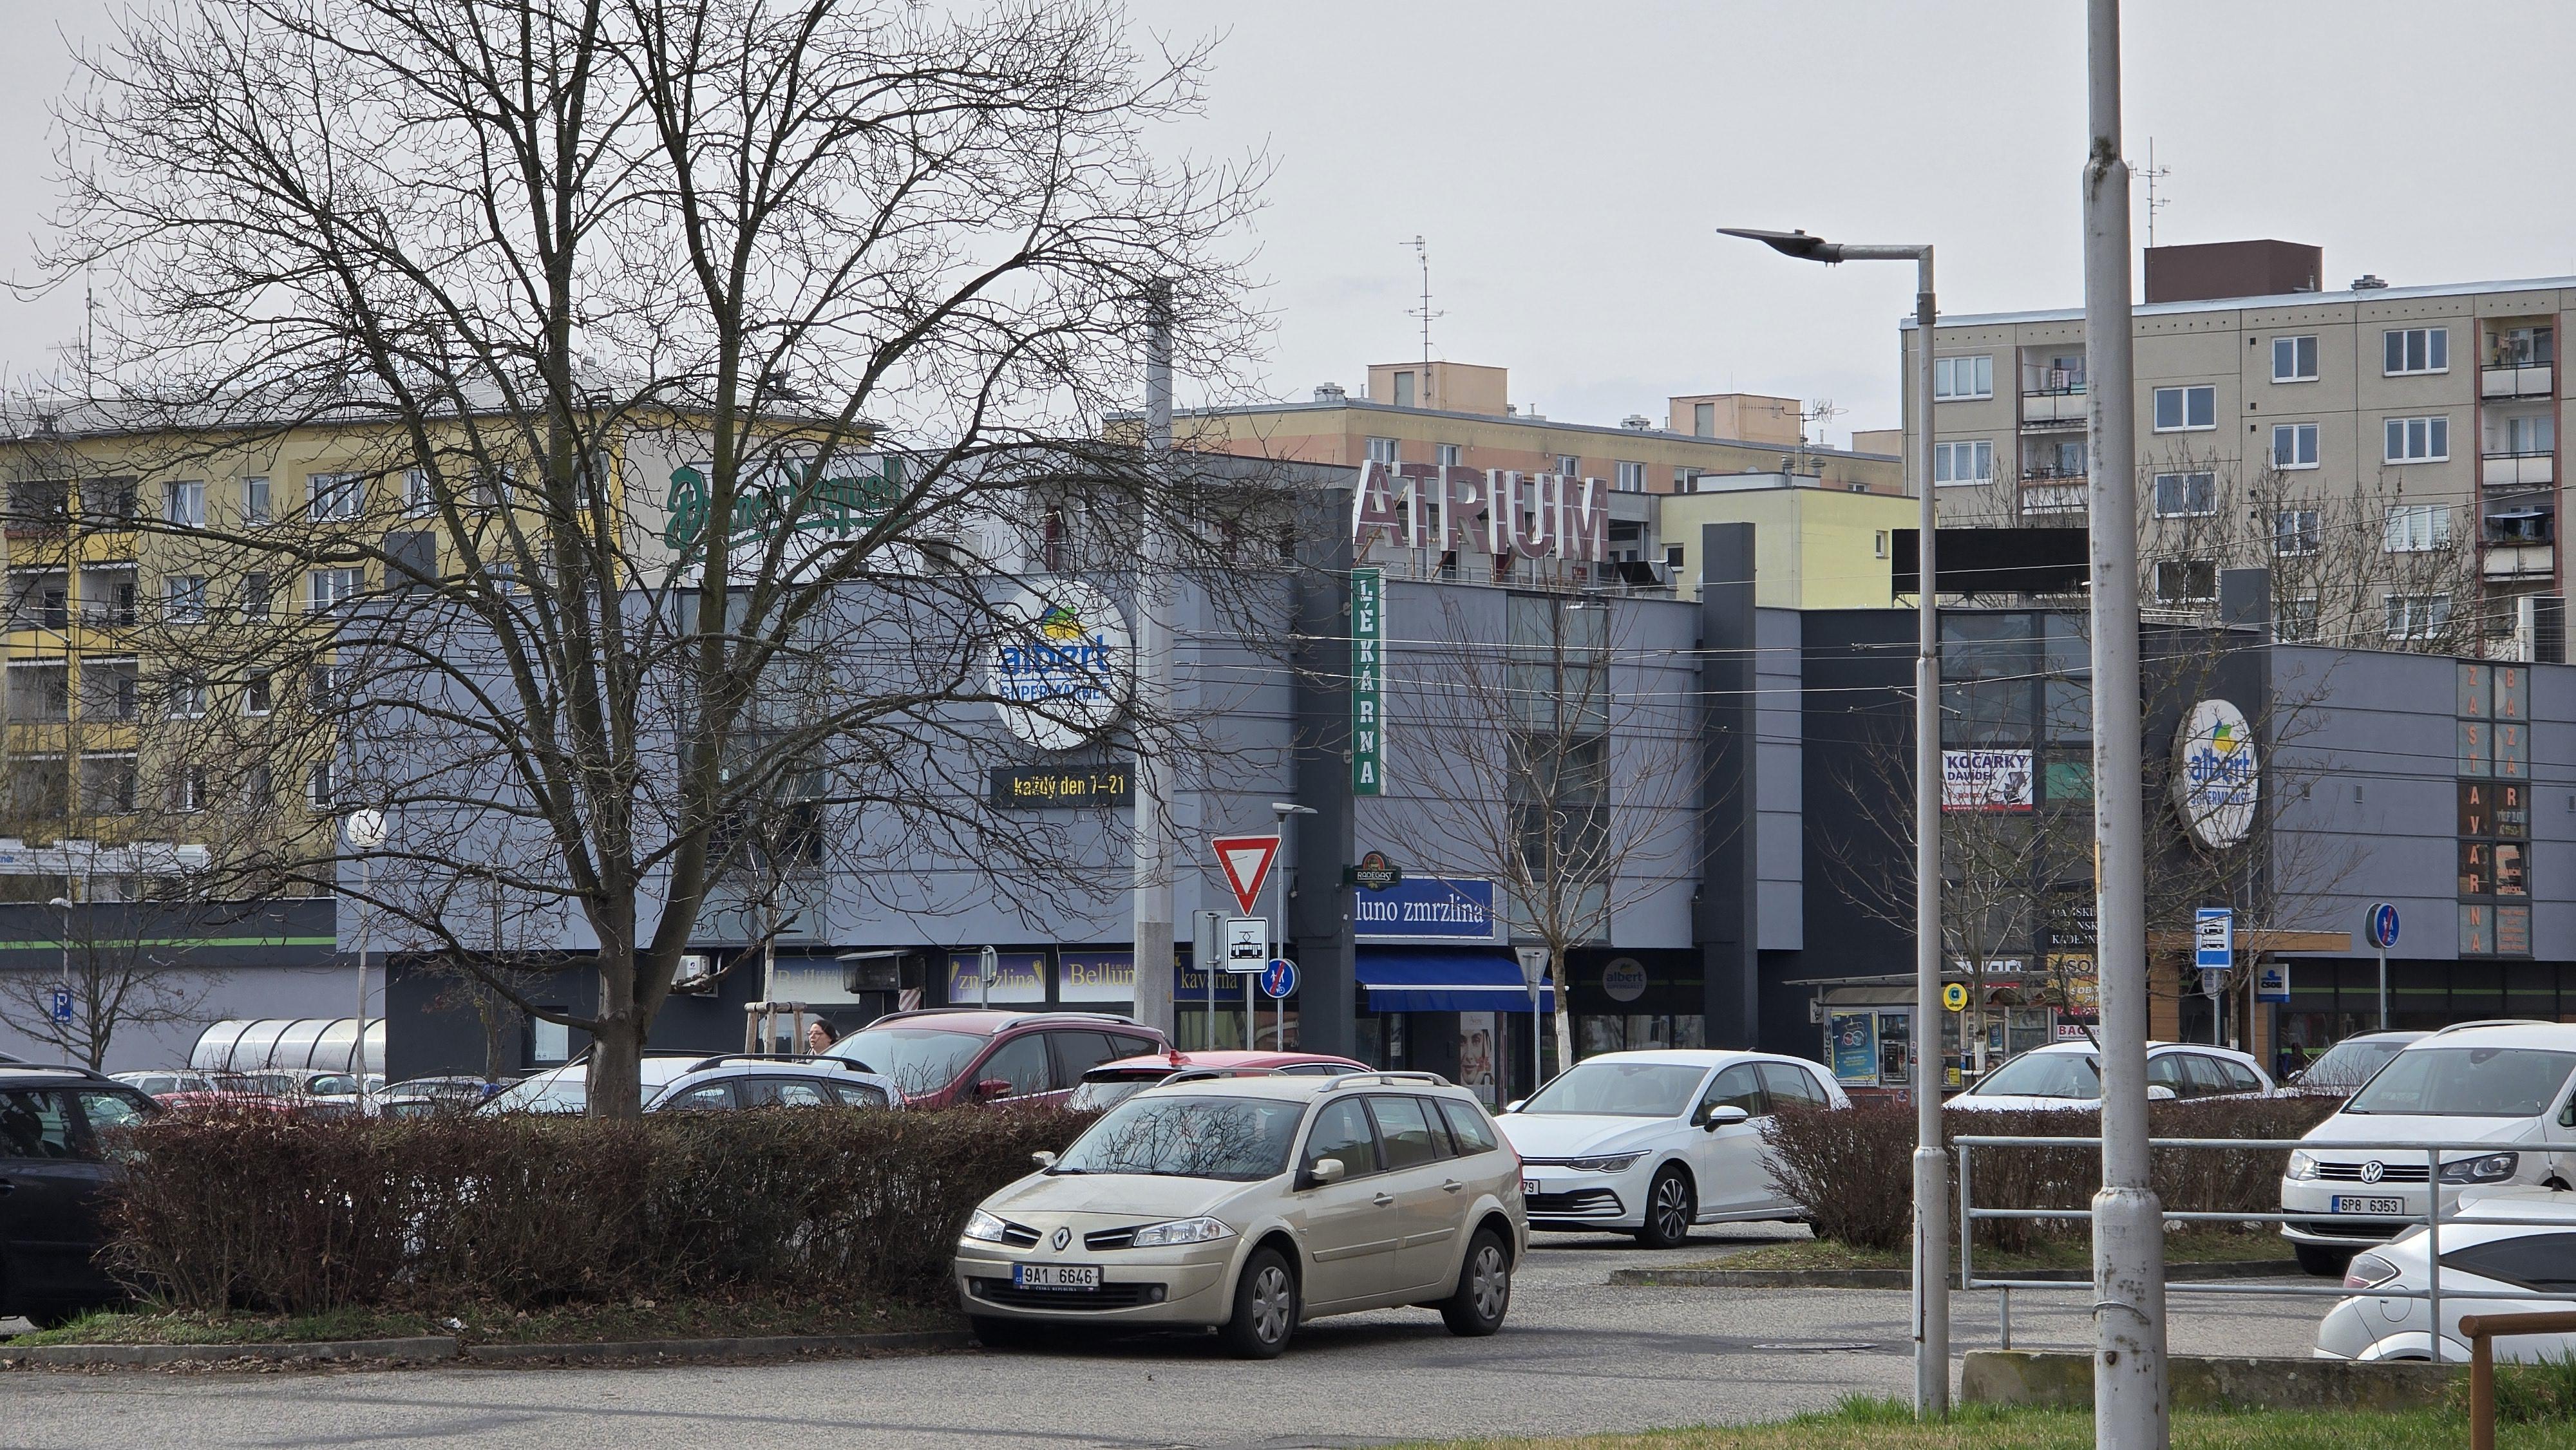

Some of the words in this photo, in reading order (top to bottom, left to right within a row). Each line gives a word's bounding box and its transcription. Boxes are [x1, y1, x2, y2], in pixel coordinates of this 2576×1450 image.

[1353, 459, 1609, 562] ATRIUM
[1000, 634, 1110, 676] albert
[1360, 579, 1374, 783] LÉKÁRNA
[2506, 669, 2516, 805] BAZAR
[1948, 753, 2028, 769] KOČÁRKY
[1014, 775, 1056, 799] každý
[1061, 776, 1086, 795] den
[1357, 871, 1393, 881] RADEGAST
[1404, 893, 1484, 923] zmrzlina
[958, 968, 1036, 990] zmzlina
[1180, 967, 1238, 989] kavrna
[1607, 971, 1643, 982] albert
[2342, 1199, 2362, 1211] 6P8
[2370, 1200, 2398, 1212] 6353
[1025, 1268, 1048, 1283] 9A1
[1059, 1269, 1092, 1284] 6646
